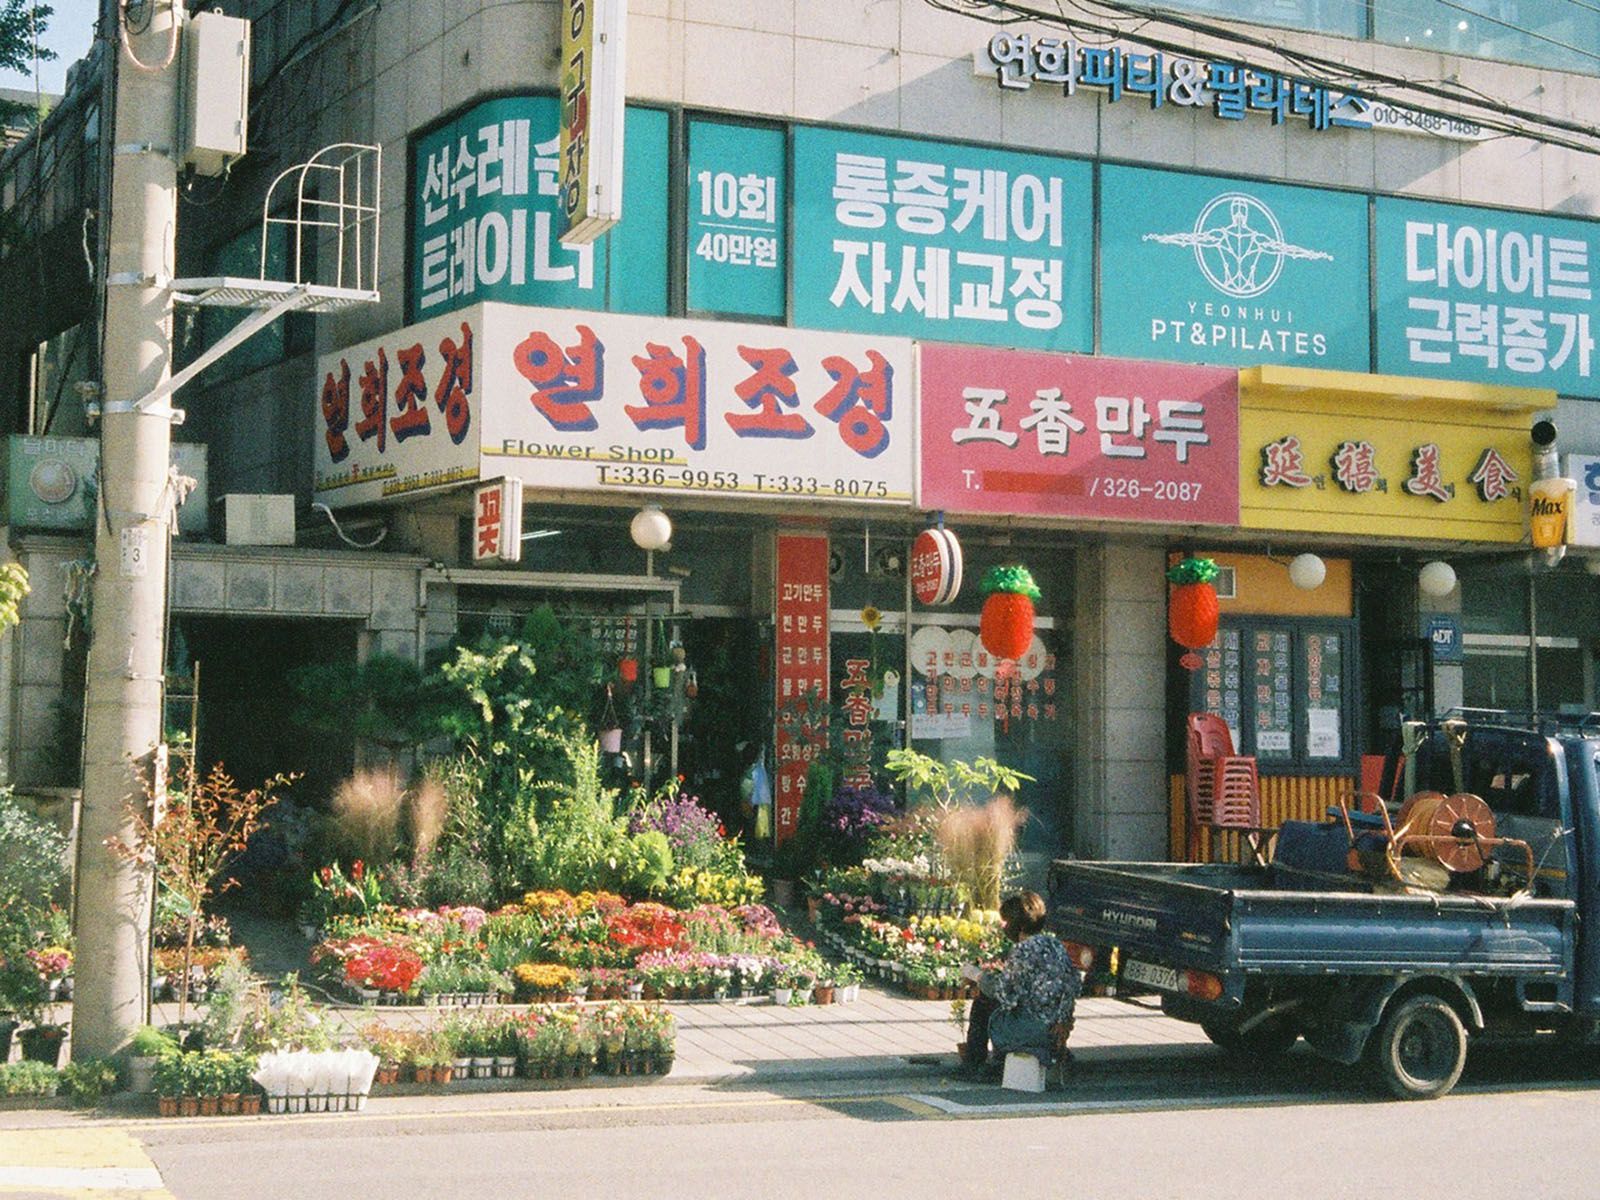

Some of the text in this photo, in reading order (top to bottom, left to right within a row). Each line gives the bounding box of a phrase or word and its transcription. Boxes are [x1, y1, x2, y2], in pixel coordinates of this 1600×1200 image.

[698, 171, 776, 223] 10회
[832, 153, 1063, 248] 통증케어
[421, 208, 593, 310] 트레이너
[696, 233, 777, 268] 40만원
[1406, 220, 1592, 301] 다이어트
[829, 239, 1063, 330] 자세교정
[1187, 301, 1293, 324] YEONHUI
[1151, 319, 1327, 356] PT&PILATES
[1406, 297, 1595, 377] 근력증가
[513, 324, 894, 459] 연희조경
[501, 438, 675, 463] Flower Shop
[596, 464, 889, 497] T:336-9953 T:333-8075
[478, 488, 501, 558] 꽃
[1531, 498, 1563, 517] Max
[132, 547, 141, 563] 3
[782, 584, 823, 602] 고기만두
[1432, 629, 1453, 644] ADT
